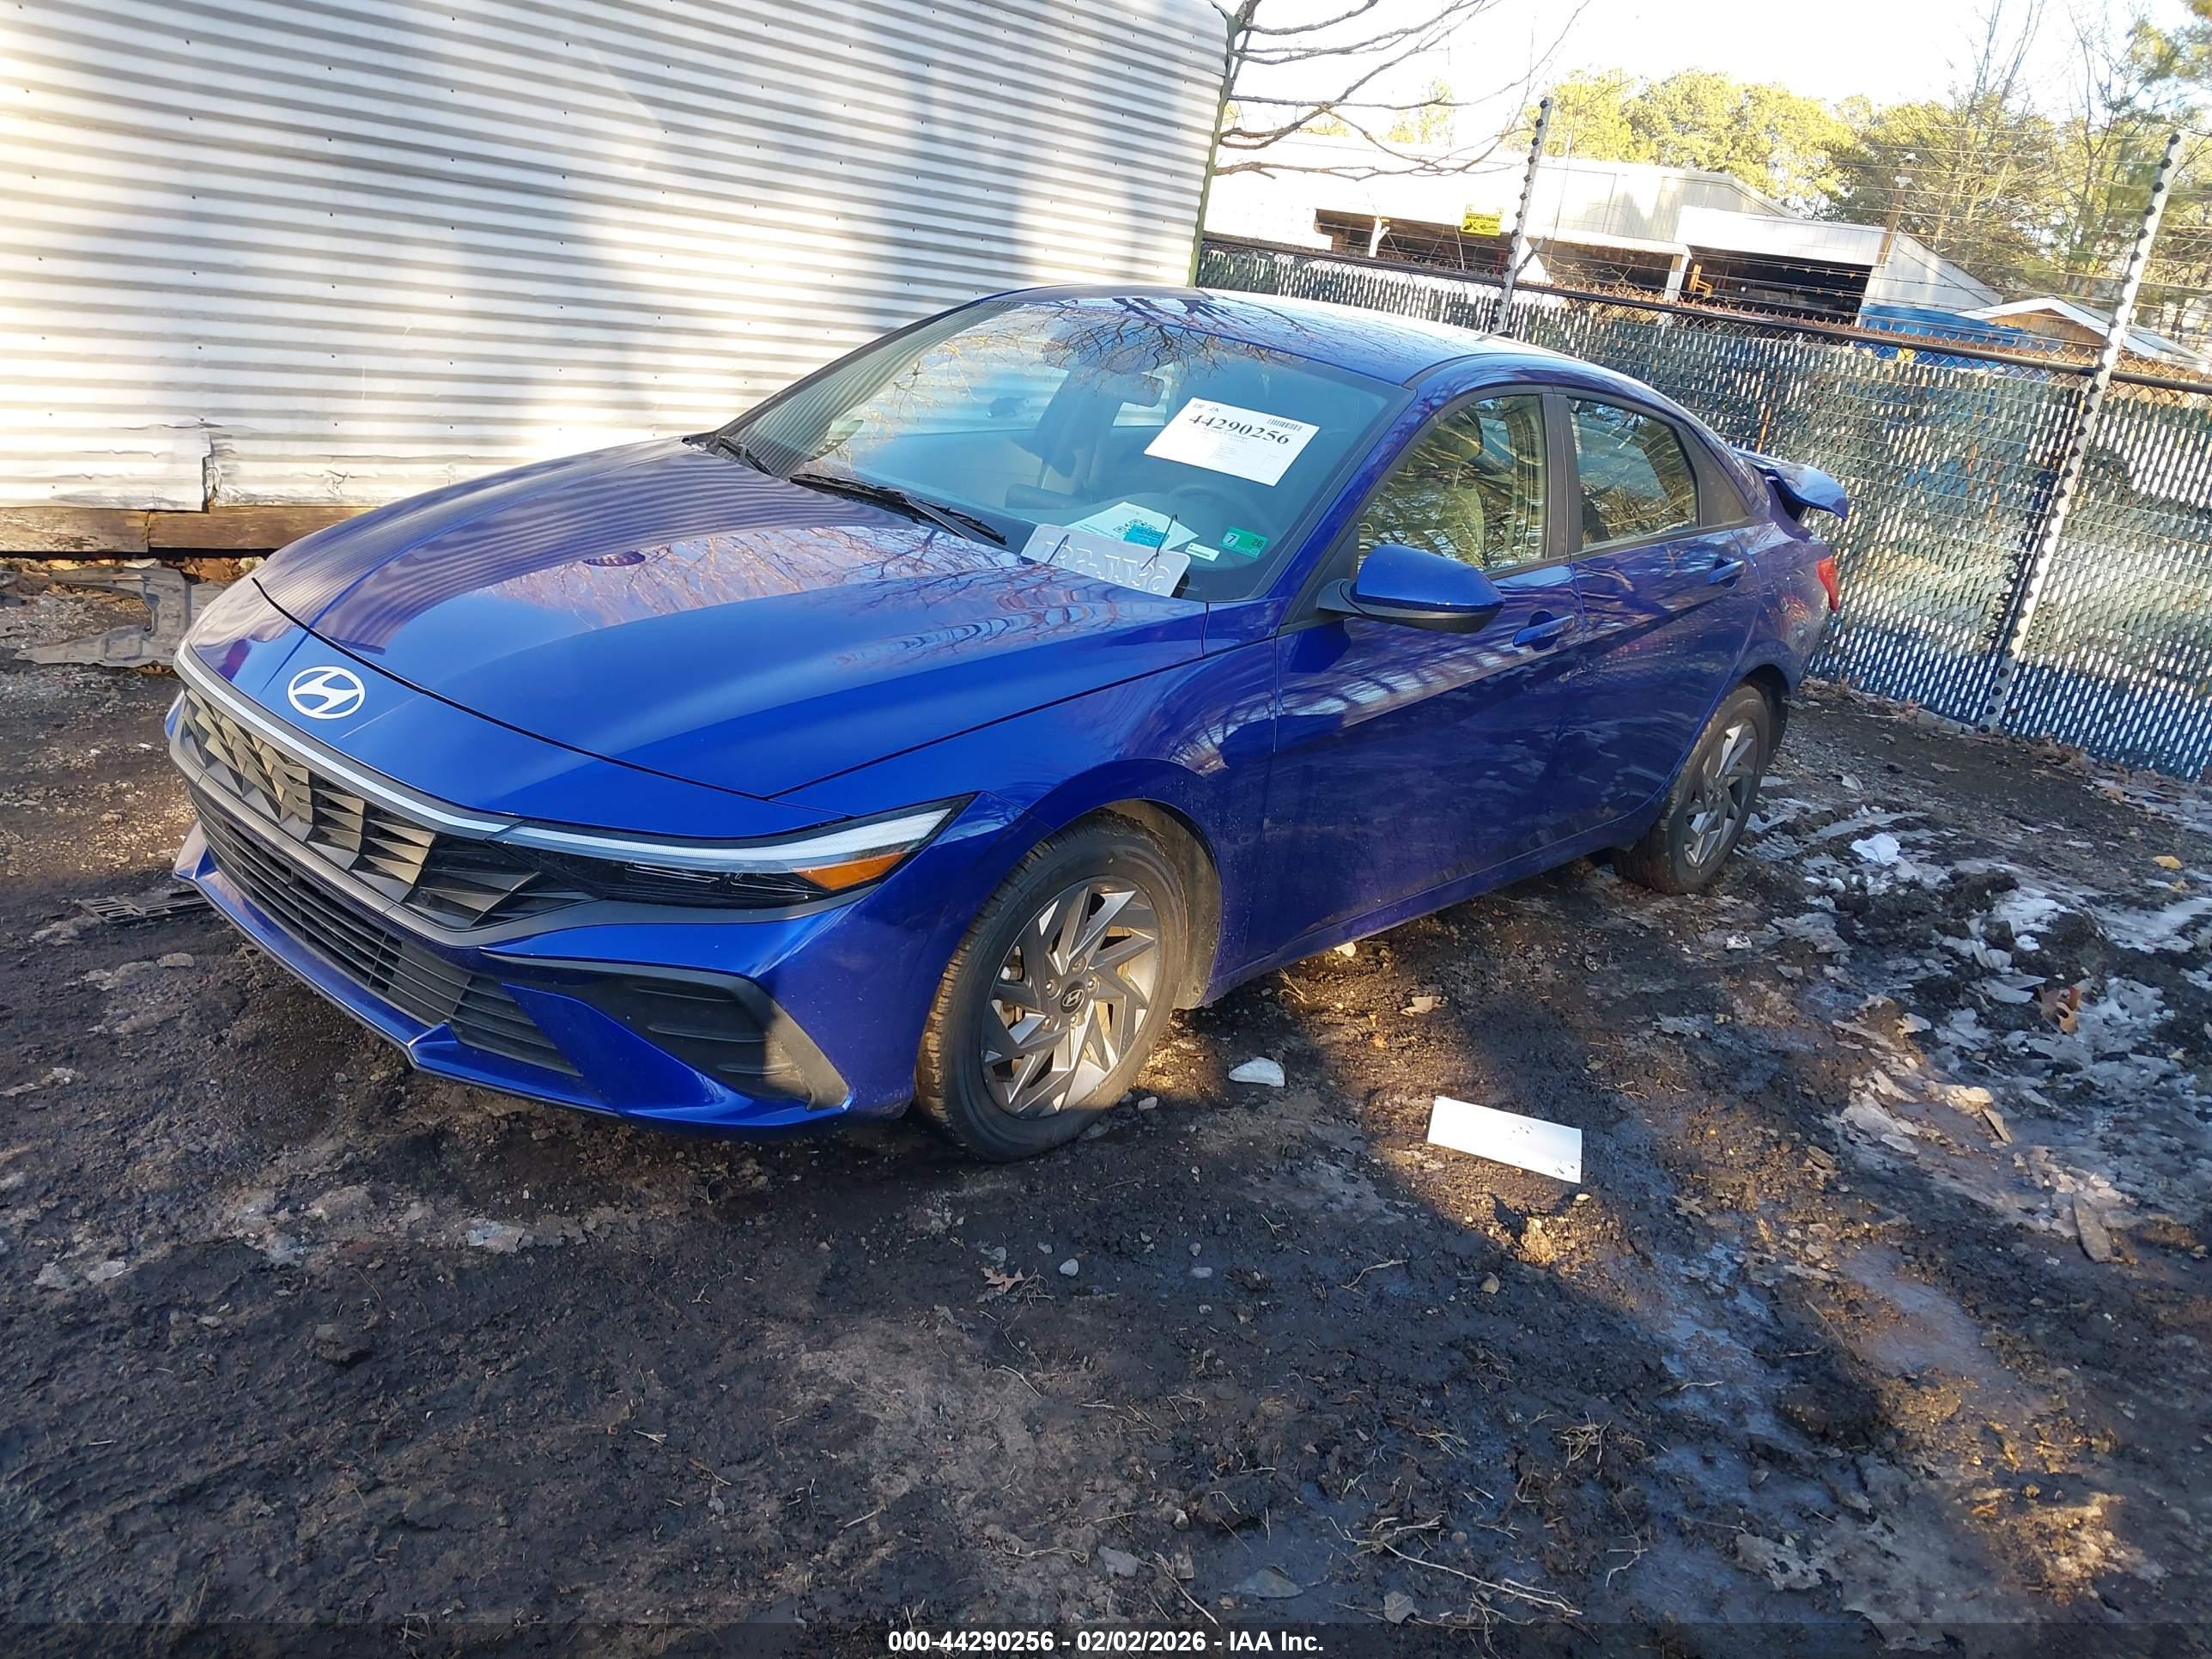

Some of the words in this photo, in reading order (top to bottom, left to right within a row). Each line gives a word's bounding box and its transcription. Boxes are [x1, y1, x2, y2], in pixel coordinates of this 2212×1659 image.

[1189, 414, 1292, 445] 44290256
[1228, 534, 1237, 544] 7
[1250, 538, 1264, 548] 26
